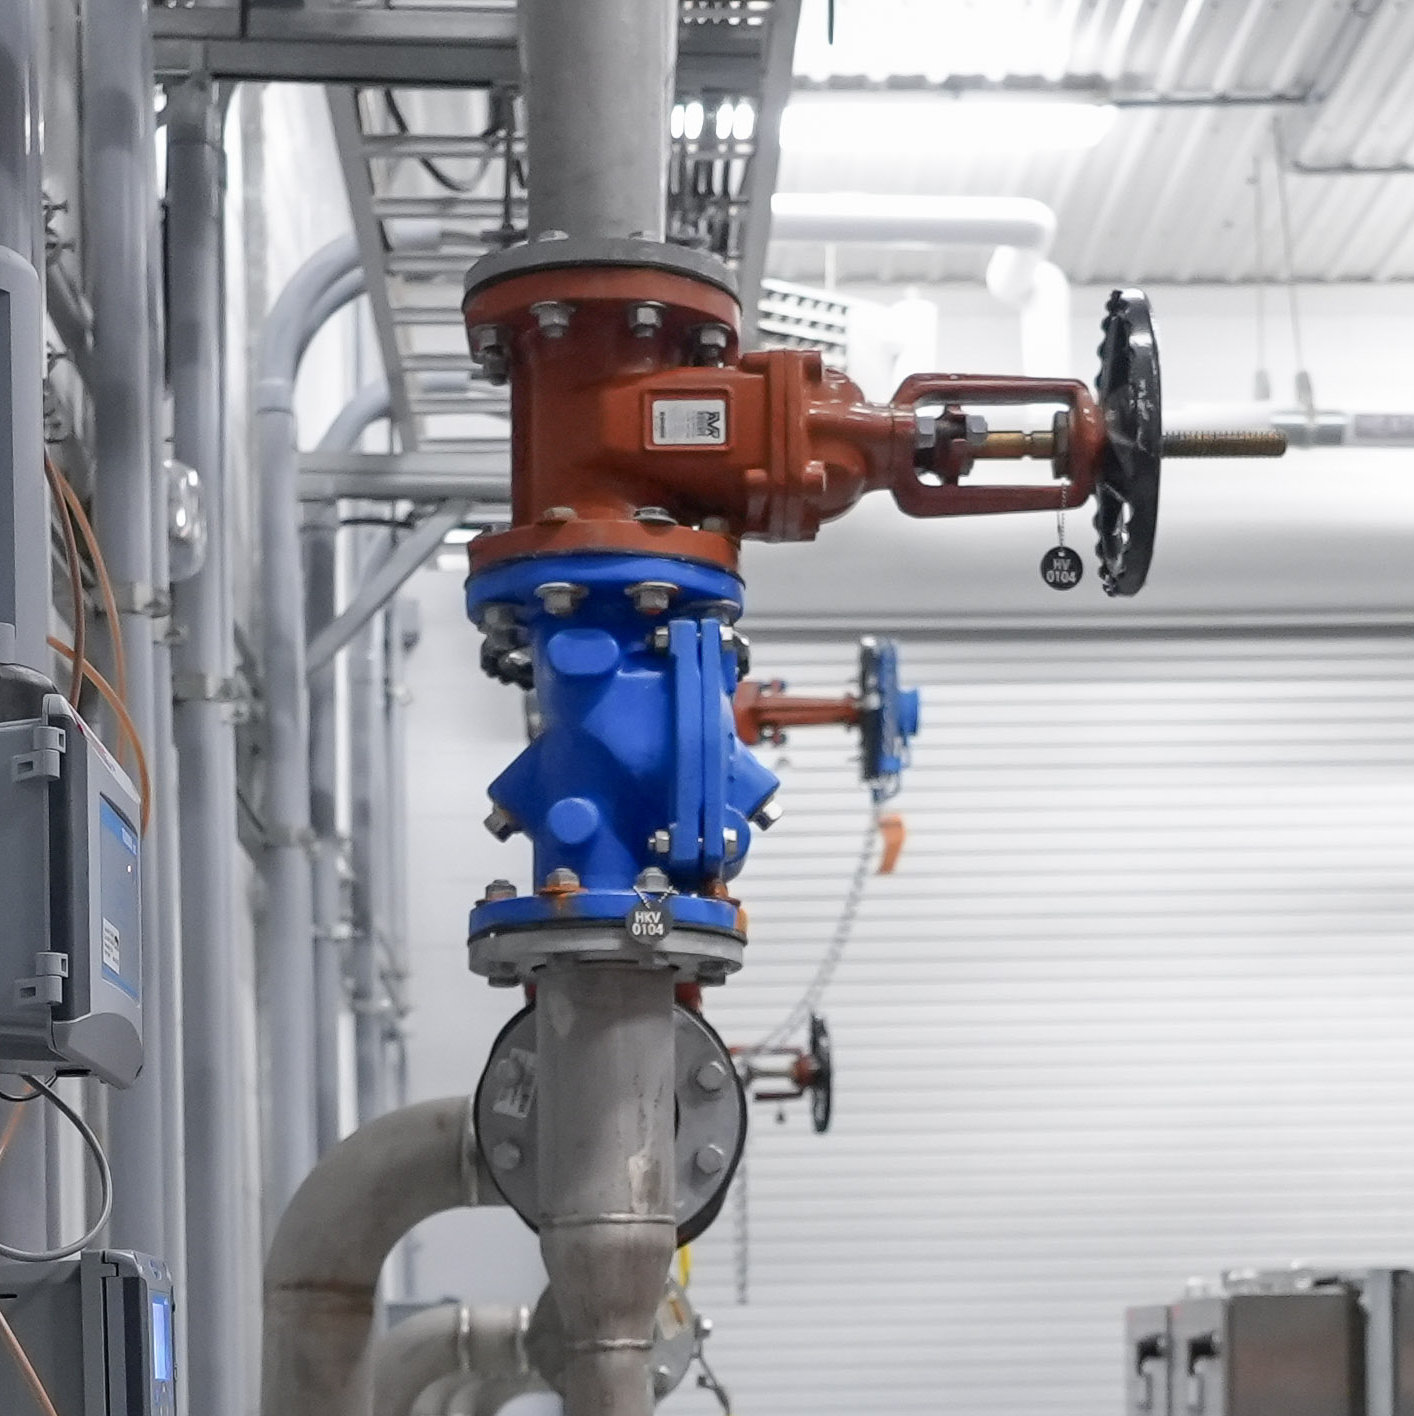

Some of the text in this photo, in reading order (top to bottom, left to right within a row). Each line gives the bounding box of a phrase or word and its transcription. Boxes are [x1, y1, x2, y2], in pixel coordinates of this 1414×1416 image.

[1046, 570, 1076, 583] 0104
[634, 911, 662, 923] HKV
[631, 923, 664, 936] 0104
